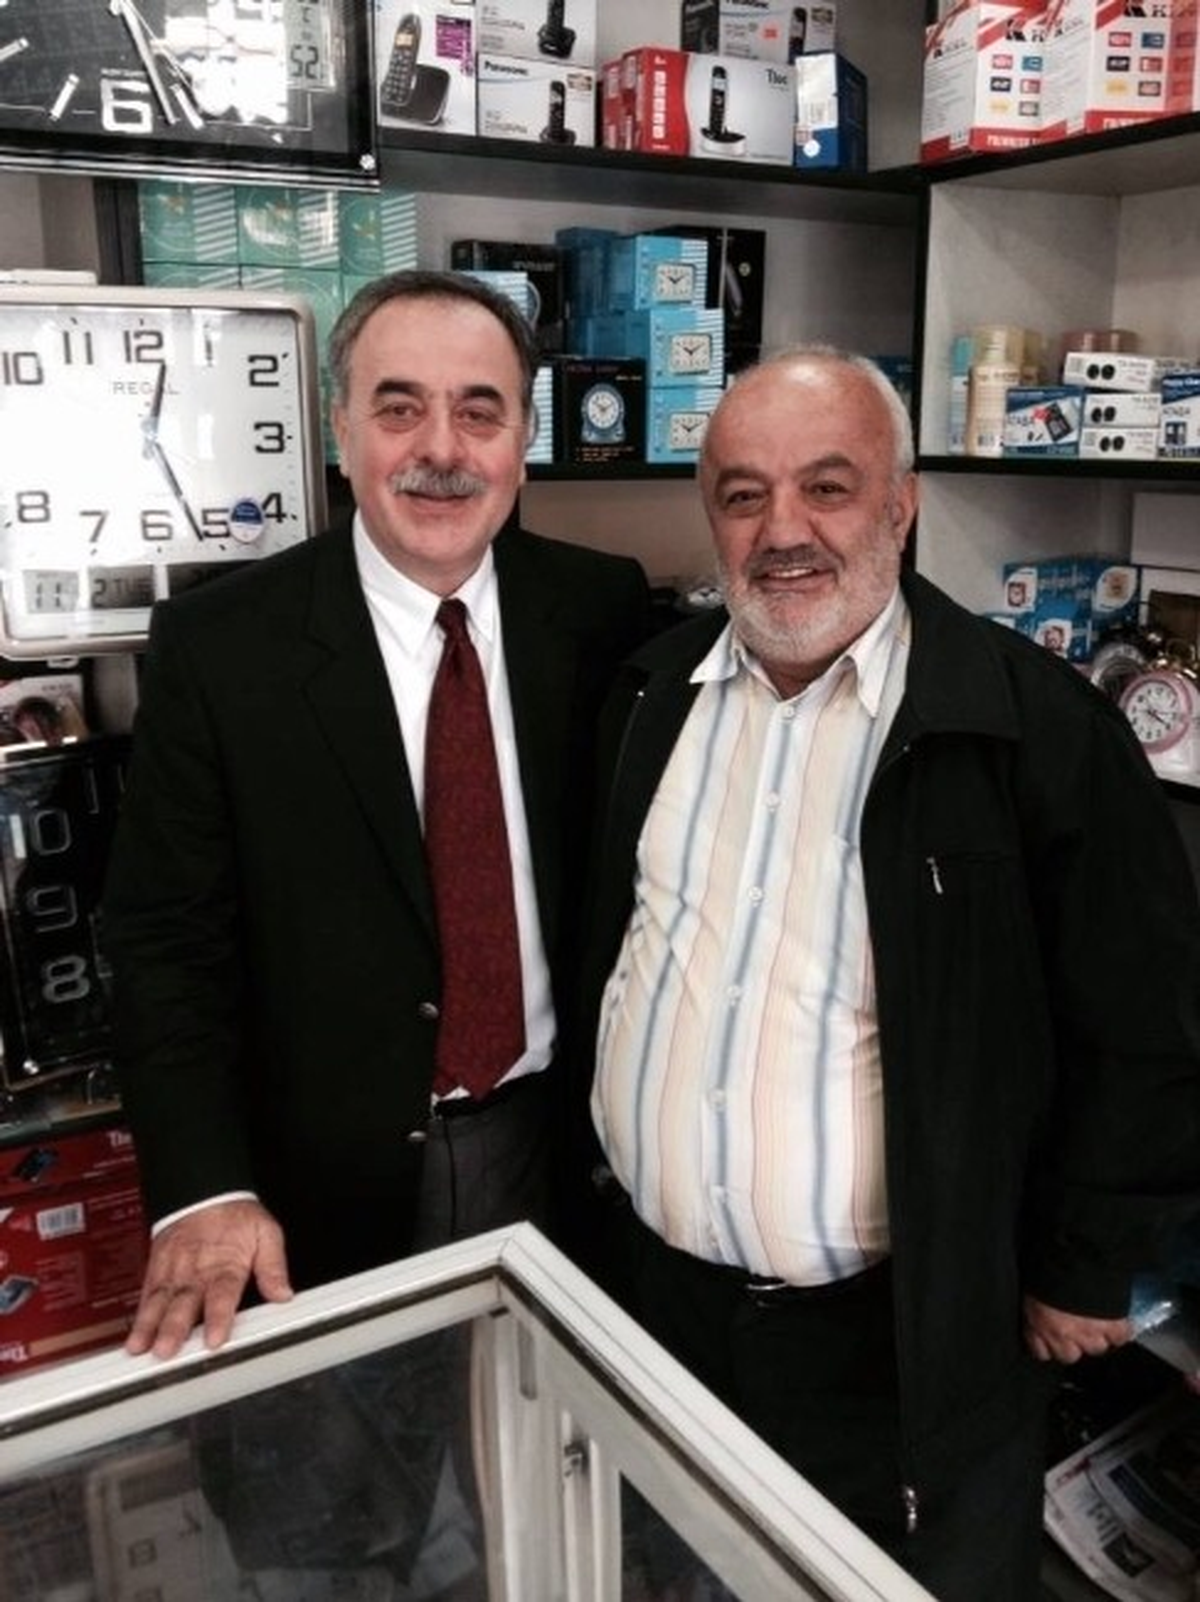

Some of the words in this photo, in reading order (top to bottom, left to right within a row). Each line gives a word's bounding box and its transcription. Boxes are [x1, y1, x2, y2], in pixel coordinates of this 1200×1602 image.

[101, 79, 152, 132] 6
[63, 331, 94, 365] 11
[123, 330, 165, 364] 12
[4, 352, 44, 386] 10
[248, 355, 280, 387] 2
[254, 422, 286, 453] 3
[16, 490, 51, 523] 8
[262, 493, 286, 523] 4
[80, 511, 109, 543] 7
[141, 510, 173, 541] 6
[201, 508, 232, 539] 5
[27, 885, 78, 932] 9
[43, 955, 90, 1003] 8
